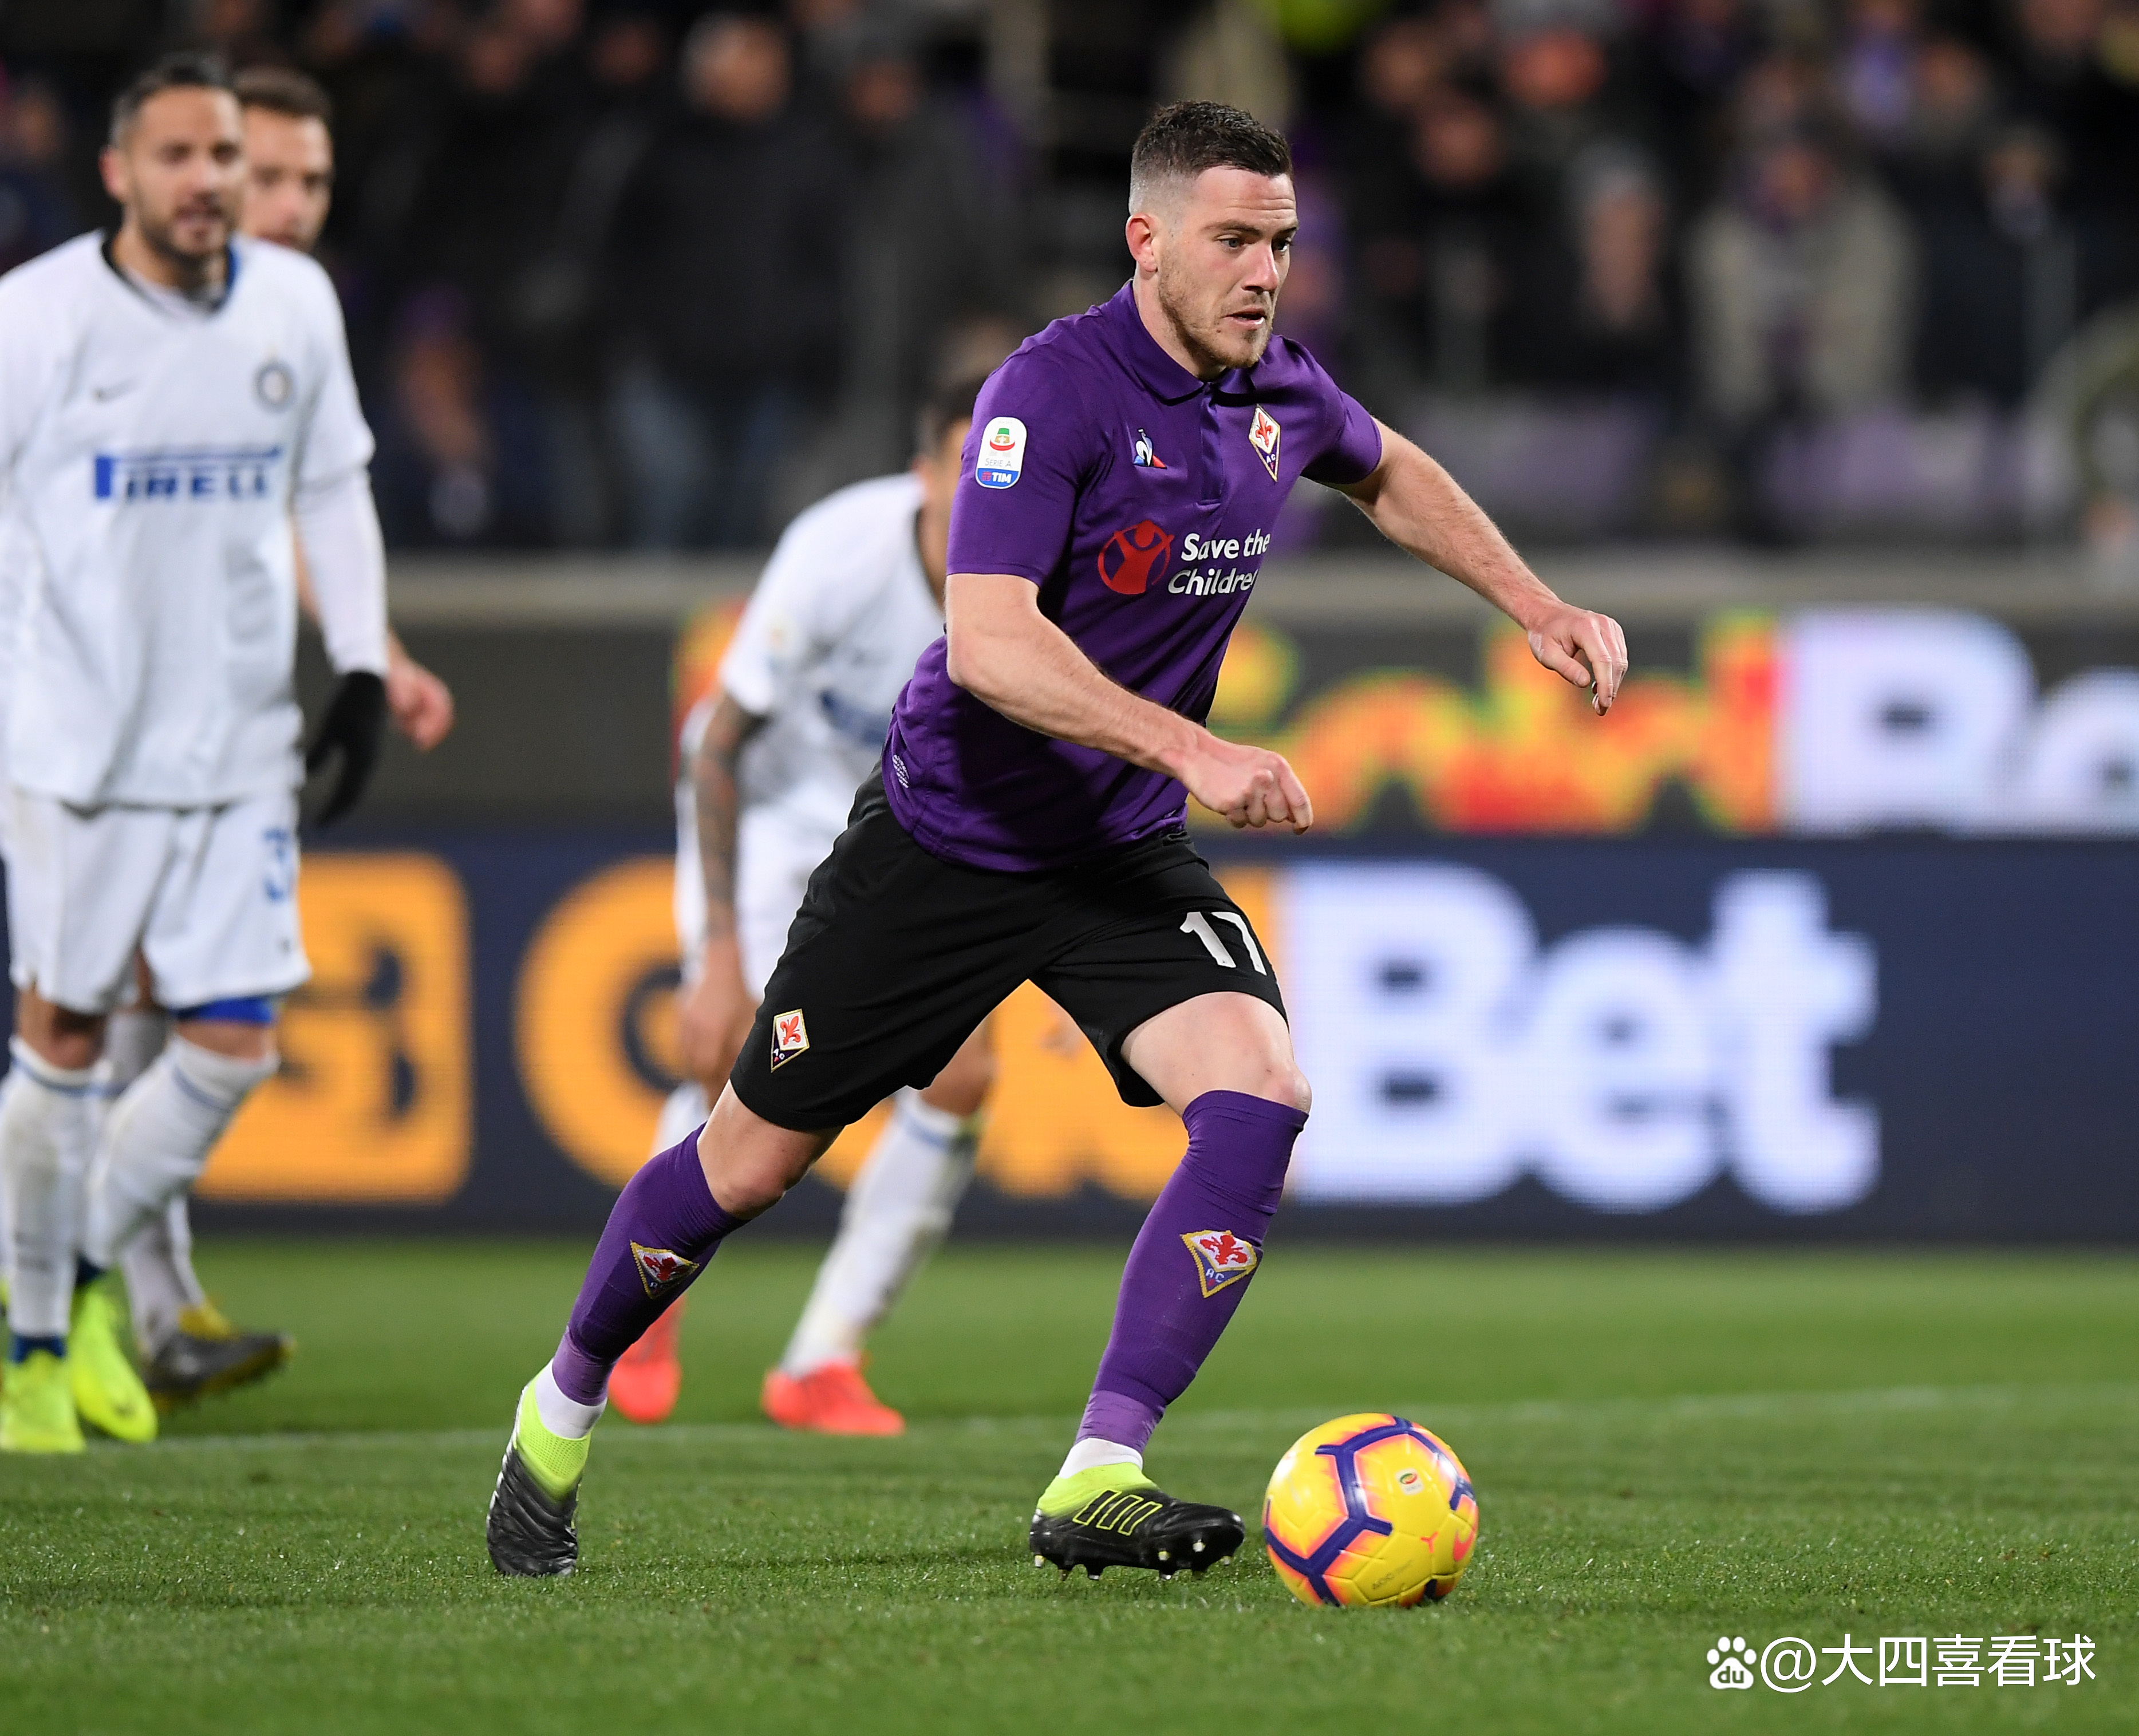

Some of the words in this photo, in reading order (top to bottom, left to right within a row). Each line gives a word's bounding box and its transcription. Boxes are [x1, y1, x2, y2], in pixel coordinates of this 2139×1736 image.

[92, 442, 282, 499] PIRELL
[985, 458, 1003, 467] SERIE
[992, 471, 1012, 483] TIM
[1181, 532, 1240, 561] Save
[1243, 528, 1270, 557] the
[1179, 911, 1268, 976] 17
